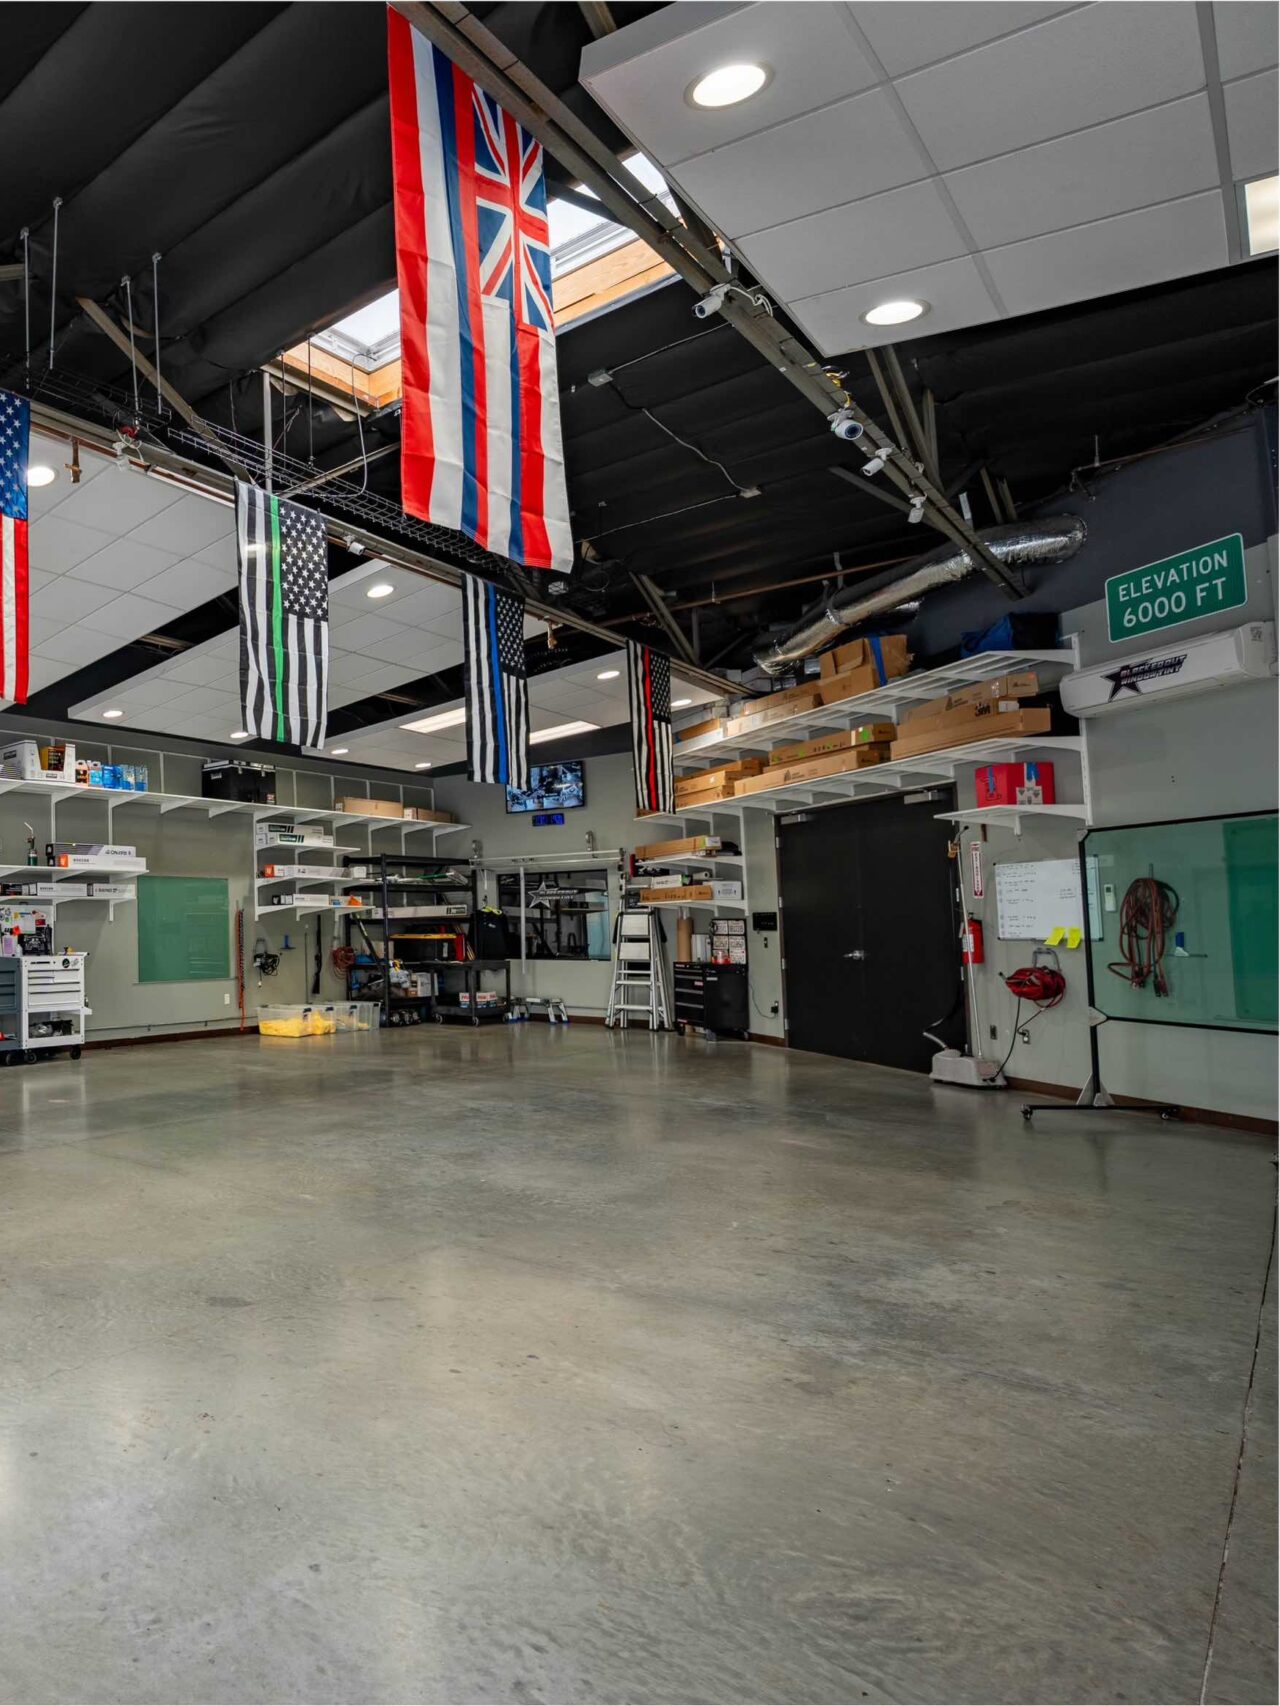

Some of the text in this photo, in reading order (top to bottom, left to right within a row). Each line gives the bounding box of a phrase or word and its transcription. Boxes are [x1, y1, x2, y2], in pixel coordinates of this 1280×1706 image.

[1118, 549, 1228, 602] ELEVATION
[1123, 577, 1227, 628] 6000 FT
